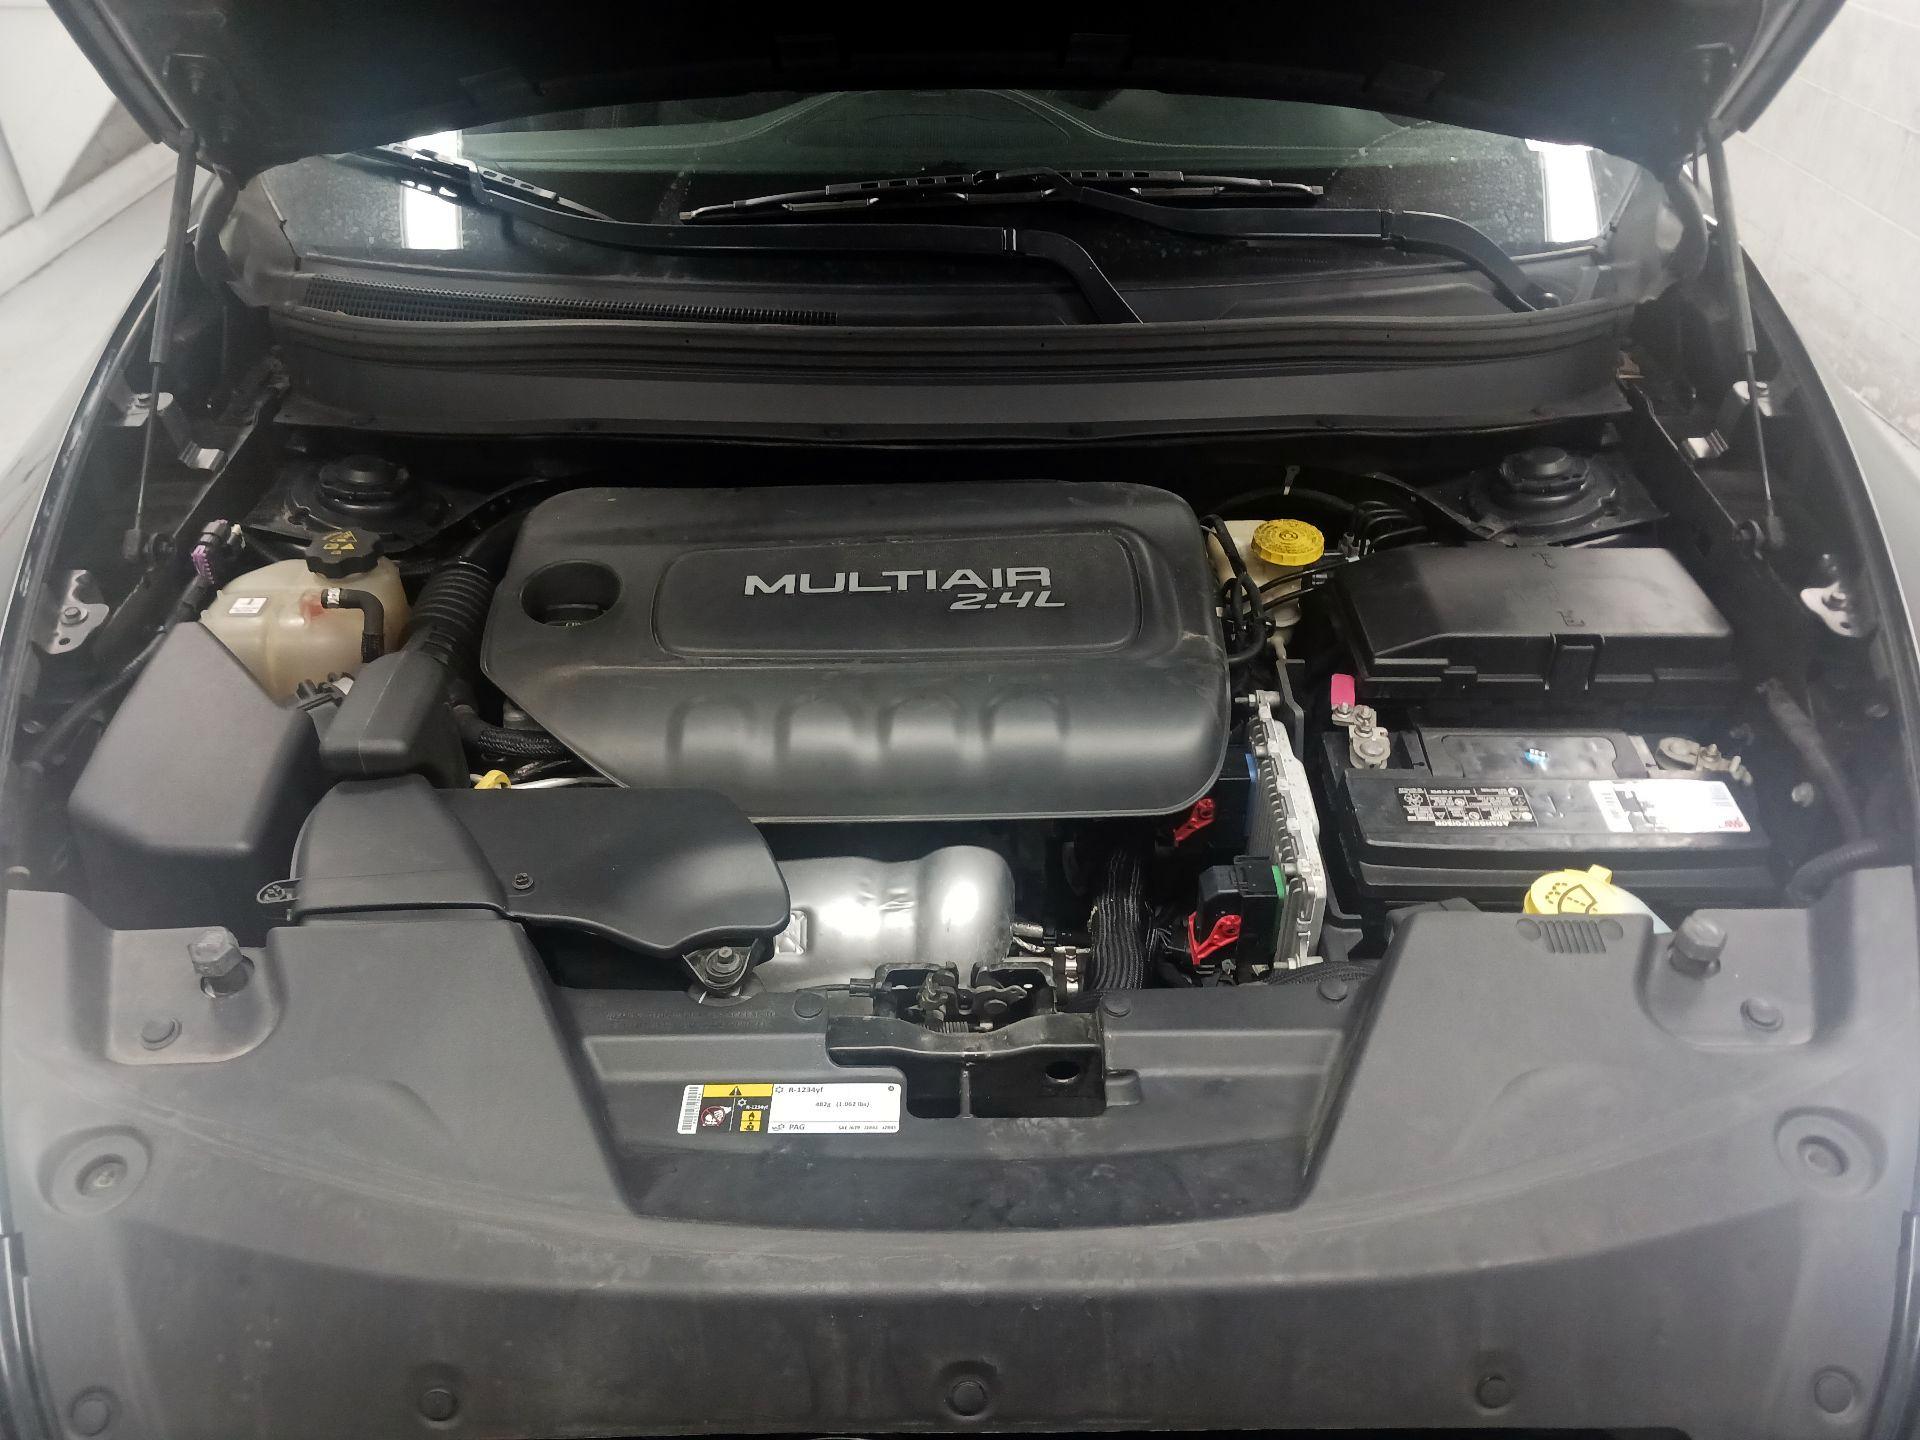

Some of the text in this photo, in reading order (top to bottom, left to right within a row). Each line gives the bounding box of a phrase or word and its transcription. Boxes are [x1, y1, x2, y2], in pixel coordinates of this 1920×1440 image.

[745, 567, 1051, 595] MULTIAIR
[950, 591, 1066, 610] 2.4L
[788, 1123, 806, 1131] PAG
